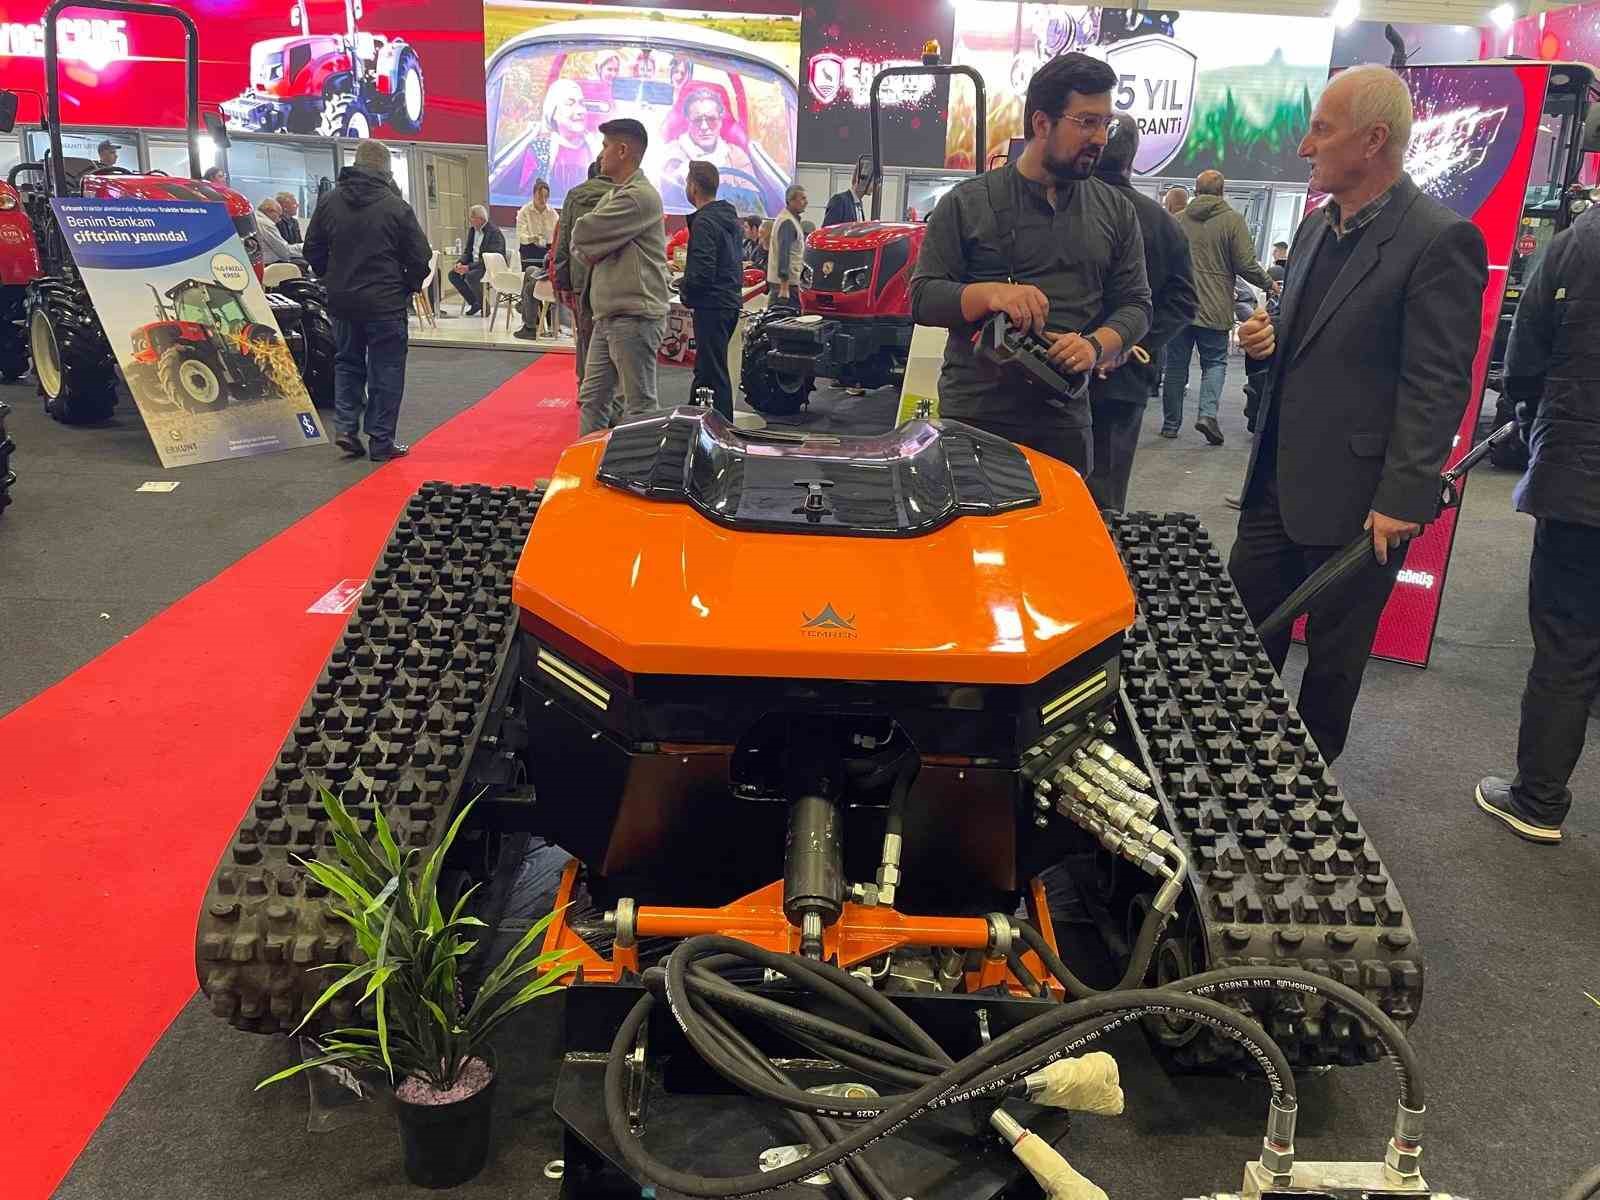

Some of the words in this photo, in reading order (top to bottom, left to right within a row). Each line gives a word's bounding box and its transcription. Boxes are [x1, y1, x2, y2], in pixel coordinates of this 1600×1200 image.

[1115, 74, 1136, 110] 5
[1144, 78, 1183, 110] YIL
[66, 215, 107, 227] Benim
[107, 215, 155, 227] Bankam
[73, 230, 130, 244] çiftçinin
[131, 230, 188, 244] yanında!
[1253, 979, 1271, 987] DIN
[1103, 1019, 1121, 1032] SAE
[950, 1092, 971, 1104] BAR
[970, 1087, 986, 1097] 330
[856, 1110, 880, 1118] 2Q25
